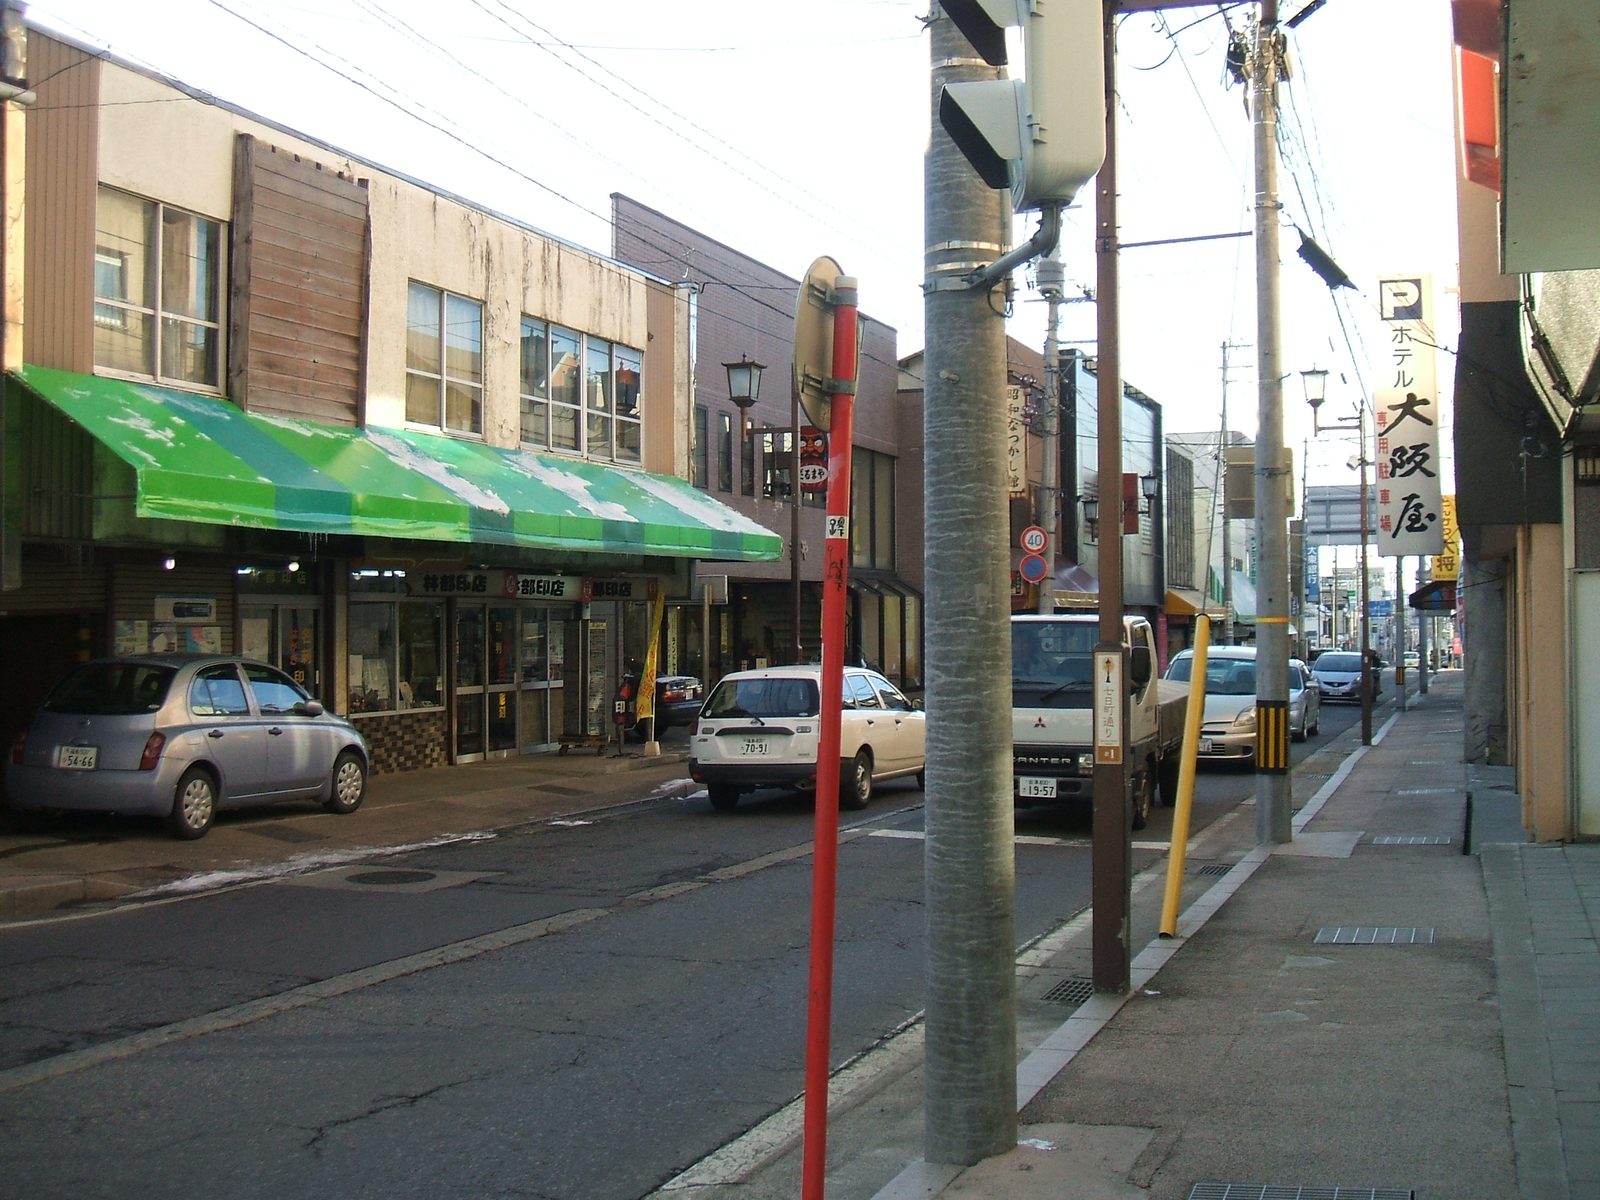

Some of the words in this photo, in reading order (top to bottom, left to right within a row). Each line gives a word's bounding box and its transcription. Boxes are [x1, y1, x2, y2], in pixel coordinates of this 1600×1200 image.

[1391, 325, 1414, 388] ホテル
[1007, 387, 1020, 488] 昭和なつかし館
[1376, 411, 1392, 532] 専用駐車場
[1378, 392, 1437, 539] 大阪屋
[1027, 534, 1042, 547] 40
[1306, 546, 1318, 584] 大東銀行
[423, 574, 487, 593] 林部印店
[517, 578, 565, 597] 部印店
[615, 700, 626, 713] 印
[1103, 686, 1115, 738] 七日町通り
[745, 743, 768, 753] 70-91
[68, 755, 93, 767] 54-66
[1029, 785, 1054, 796] 19-57
